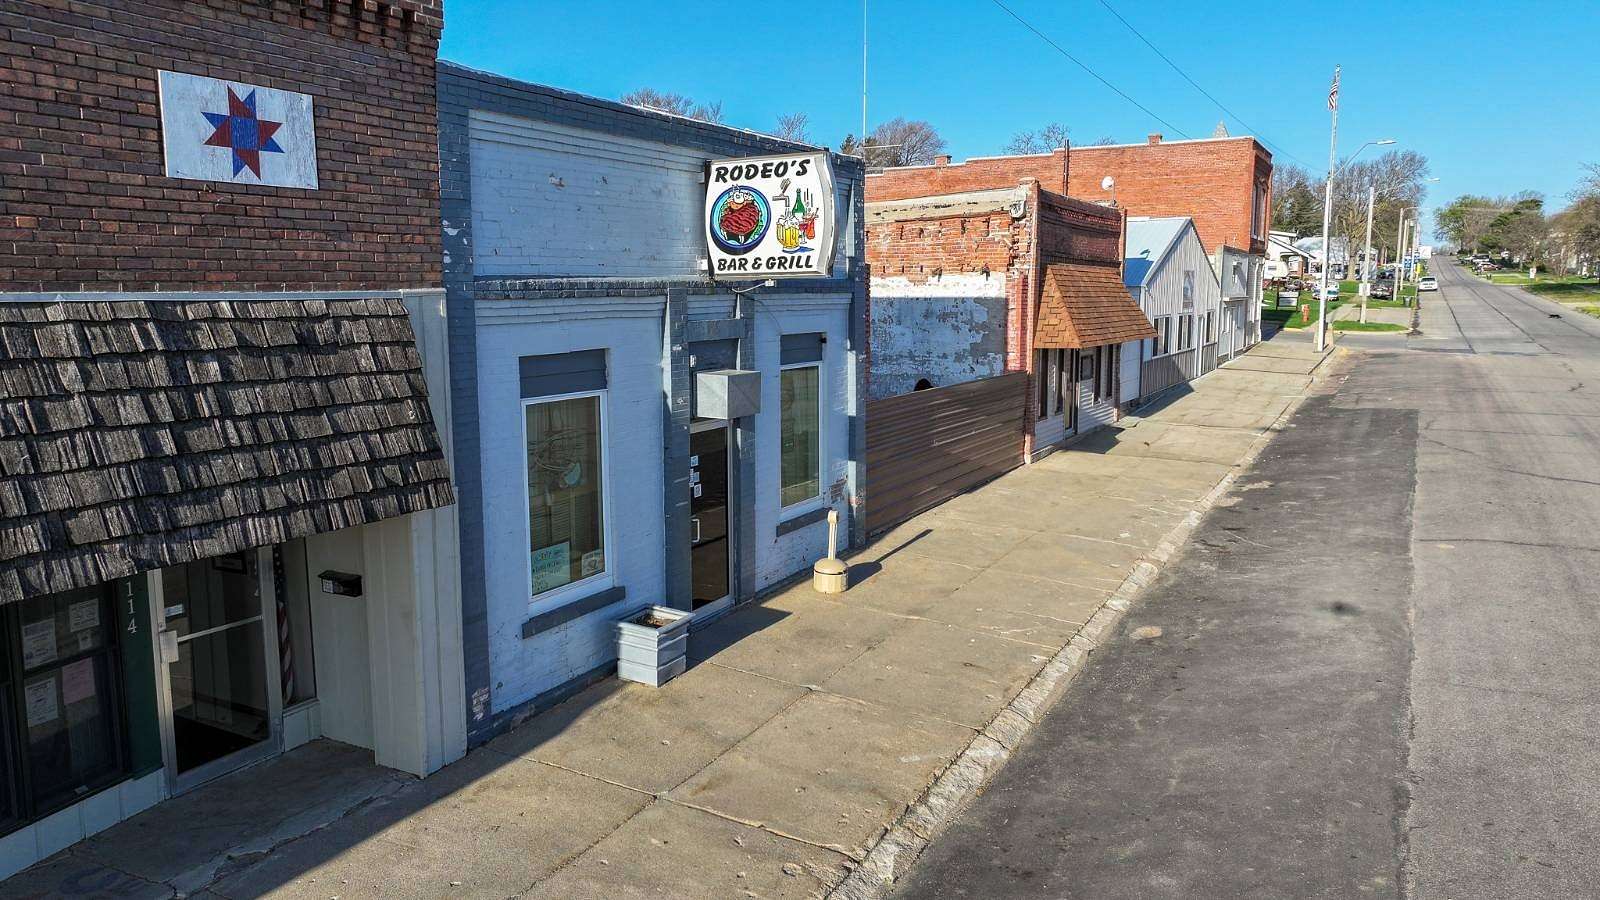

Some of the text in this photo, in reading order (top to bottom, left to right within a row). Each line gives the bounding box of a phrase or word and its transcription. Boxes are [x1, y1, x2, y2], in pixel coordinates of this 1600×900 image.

[715, 159, 810, 183] RODEO'S
[717, 255, 813, 271] BAR & GRILL
[127, 582, 138, 634] 114
